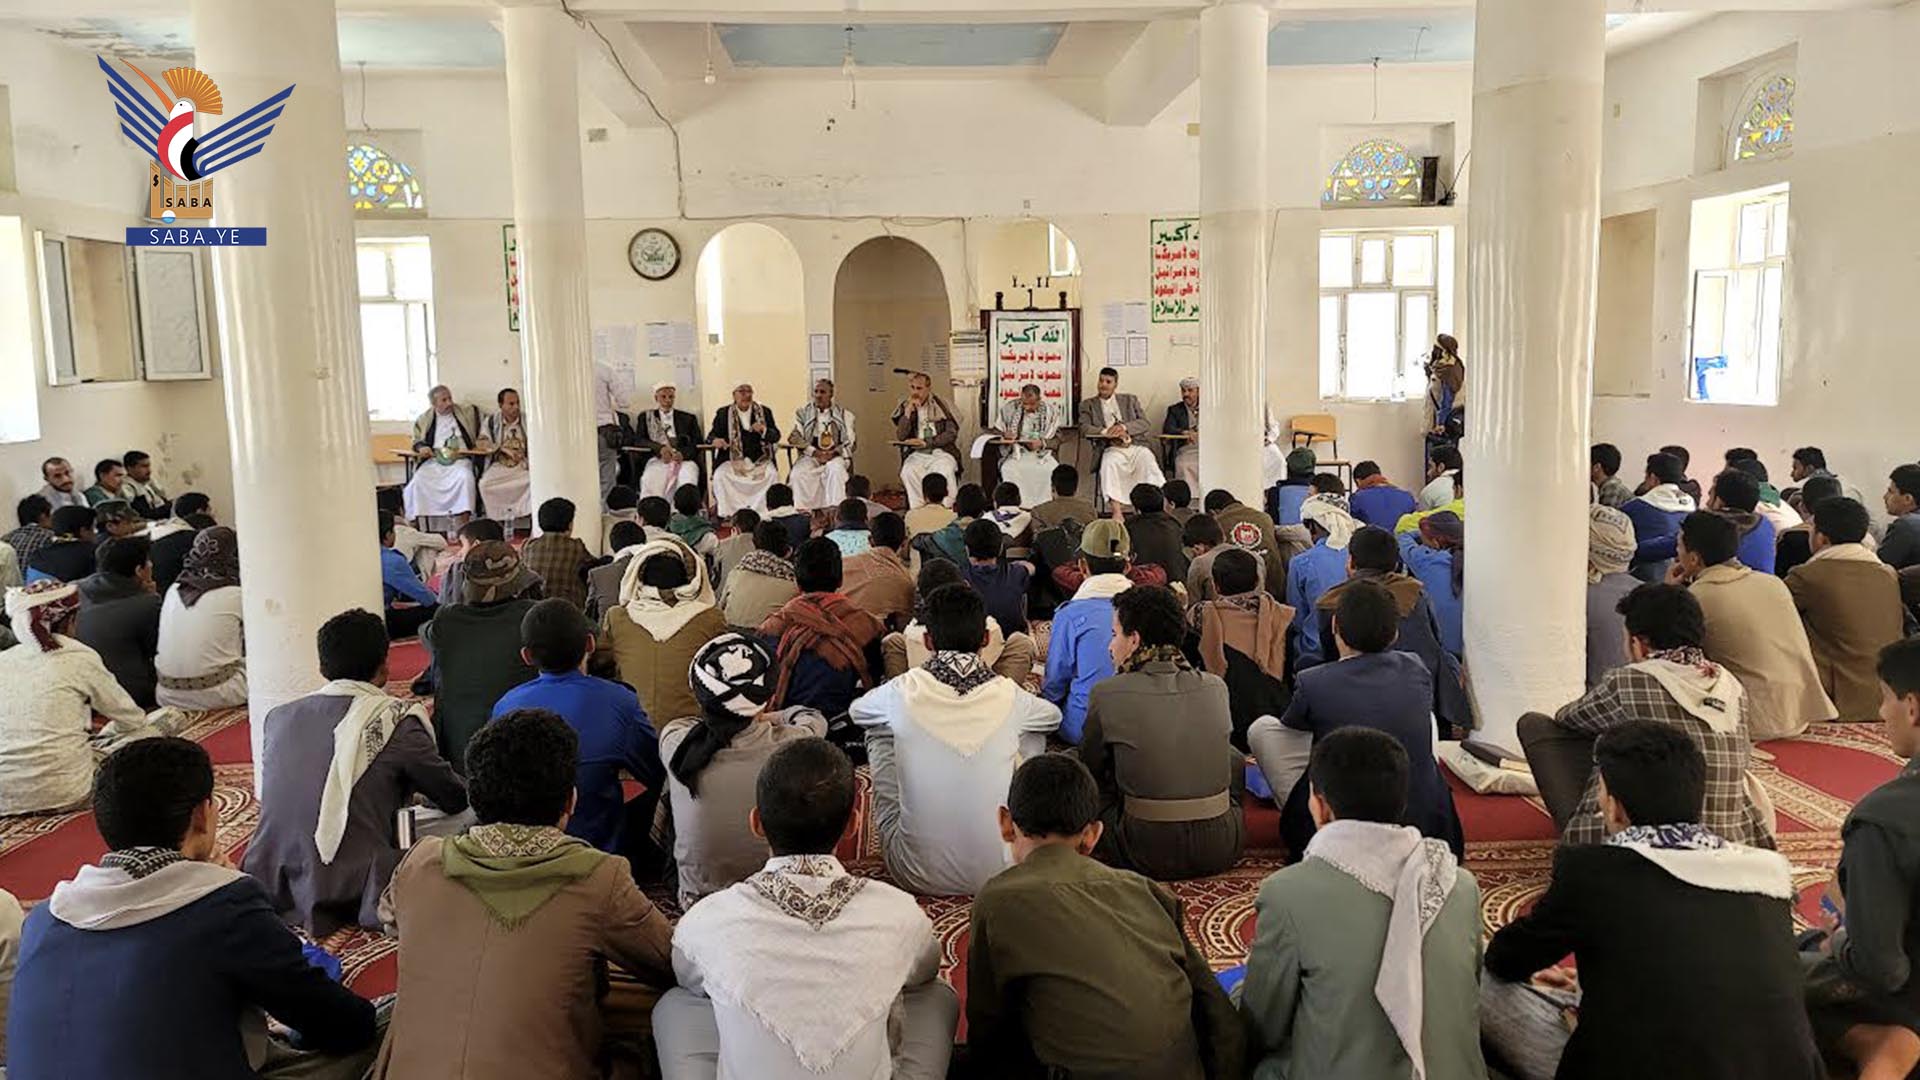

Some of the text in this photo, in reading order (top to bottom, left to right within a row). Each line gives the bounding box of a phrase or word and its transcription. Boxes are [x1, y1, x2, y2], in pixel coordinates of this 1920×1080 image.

[1155, 222, 1192, 247] أكبر
[1000, 323, 1065, 348] الله أكبر
